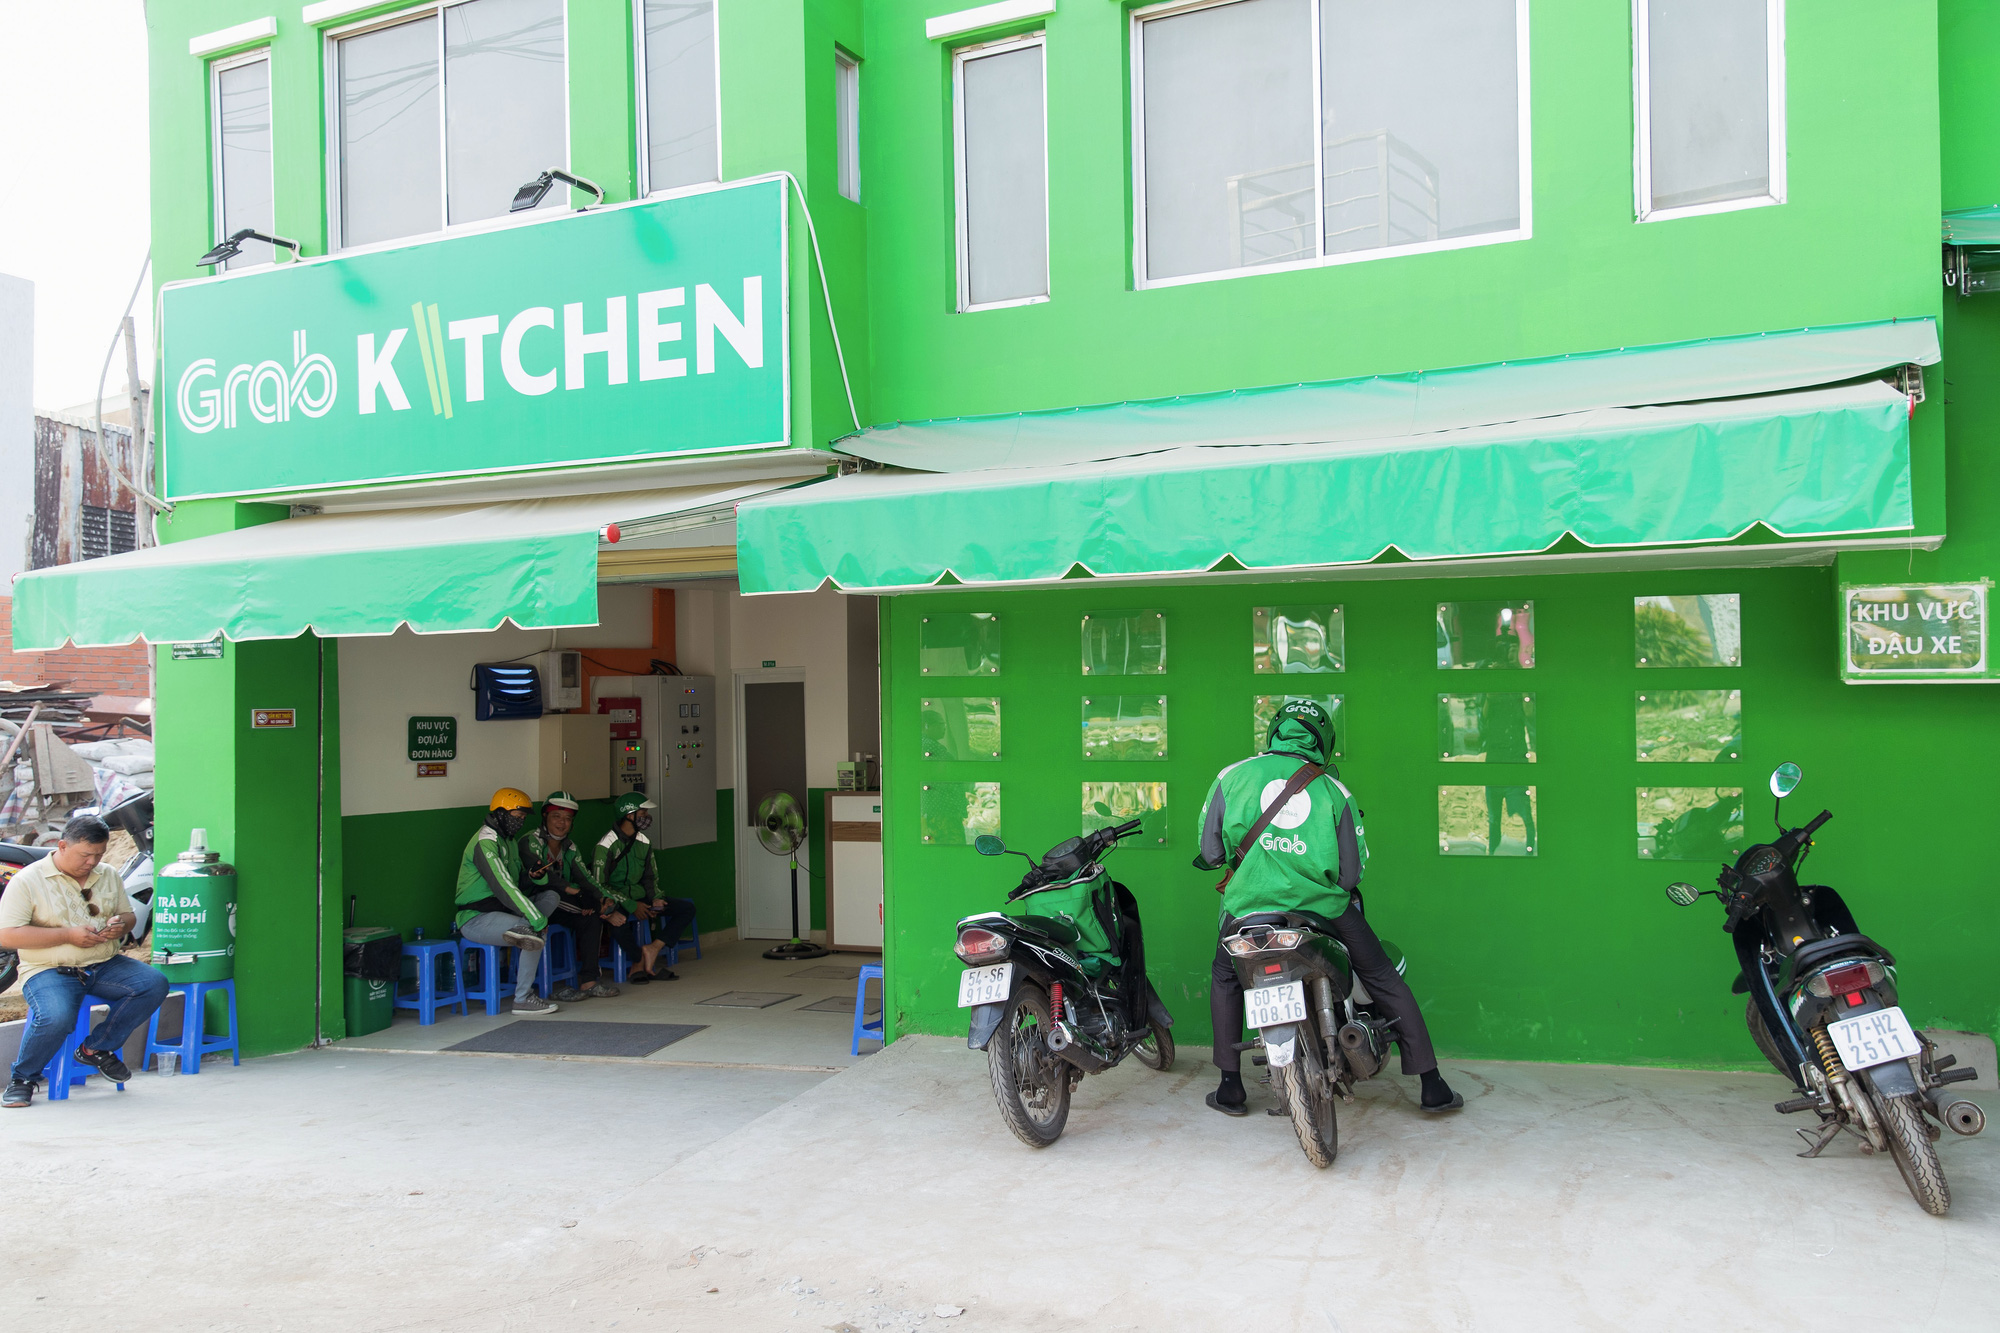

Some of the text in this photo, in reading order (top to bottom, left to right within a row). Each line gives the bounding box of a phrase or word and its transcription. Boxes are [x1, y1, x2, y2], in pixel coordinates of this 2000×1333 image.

[177, 329, 337, 434] Grab
[1857, 600, 1975, 624] KHU VỰC
[1867, 631, 1962, 659] ĐẬU XE
[1285, 704, 1319, 717] Grab
[416, 721, 450, 731] KHU VỰC
[417, 733, 448, 745] ĐỢI/LẤY
[411, 748, 453, 759] ĐƠN HÀNG
[1258, 832, 1307, 856] Grab
[157, 893, 201, 908] TRÀ ĐÁ
[180, 909, 207, 924] PHÍ
[1830, 959, 1856, 969] HONDA
[966, 983, 1002, 1003] 9194
[1253, 985, 1295, 1007] 60-F2
[1250, 1002, 1303, 1026] 108.16
[1840, 1014, 1897, 1044] 77-H2
[1850, 1034, 1905, 1065] 2511
